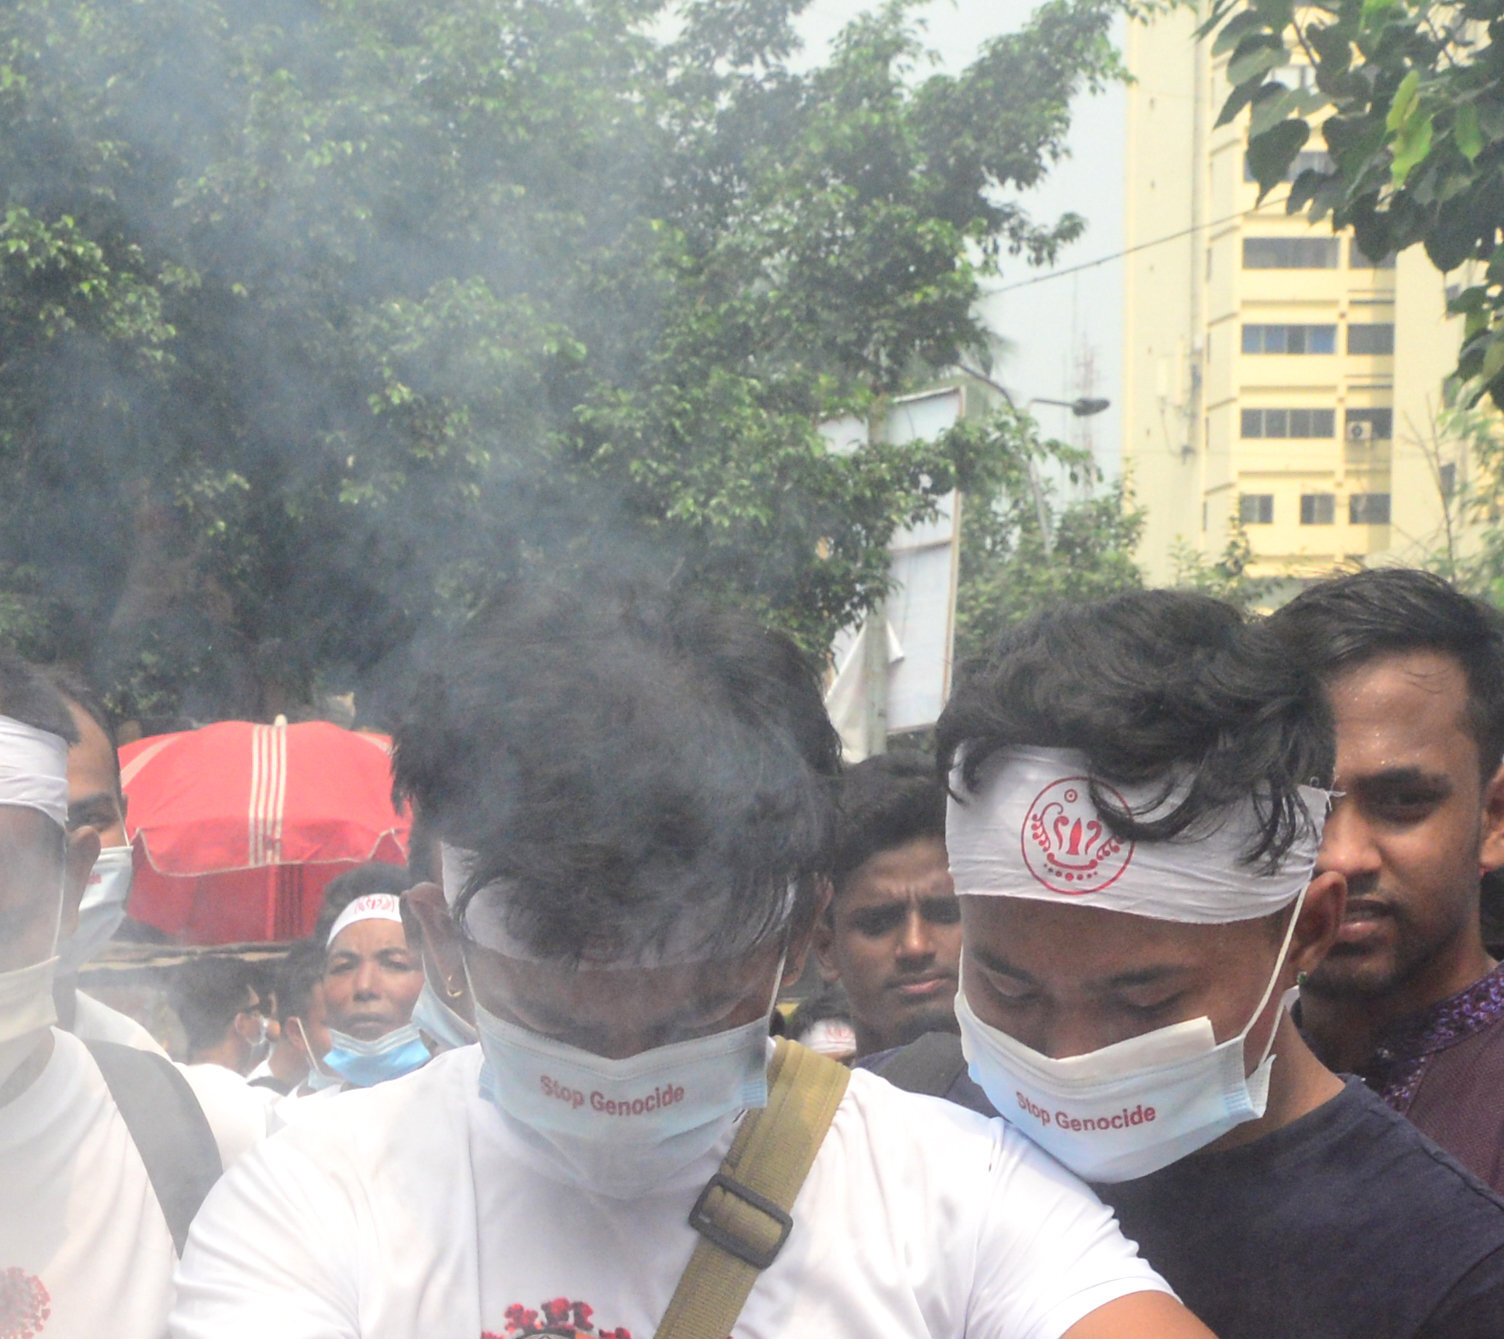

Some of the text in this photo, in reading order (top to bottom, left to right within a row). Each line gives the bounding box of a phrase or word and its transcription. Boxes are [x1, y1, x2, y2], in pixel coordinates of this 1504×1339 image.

[540, 1075, 685, 1116] Stop Genocide
[1016, 1090, 1156, 1131] Stop Genocide
